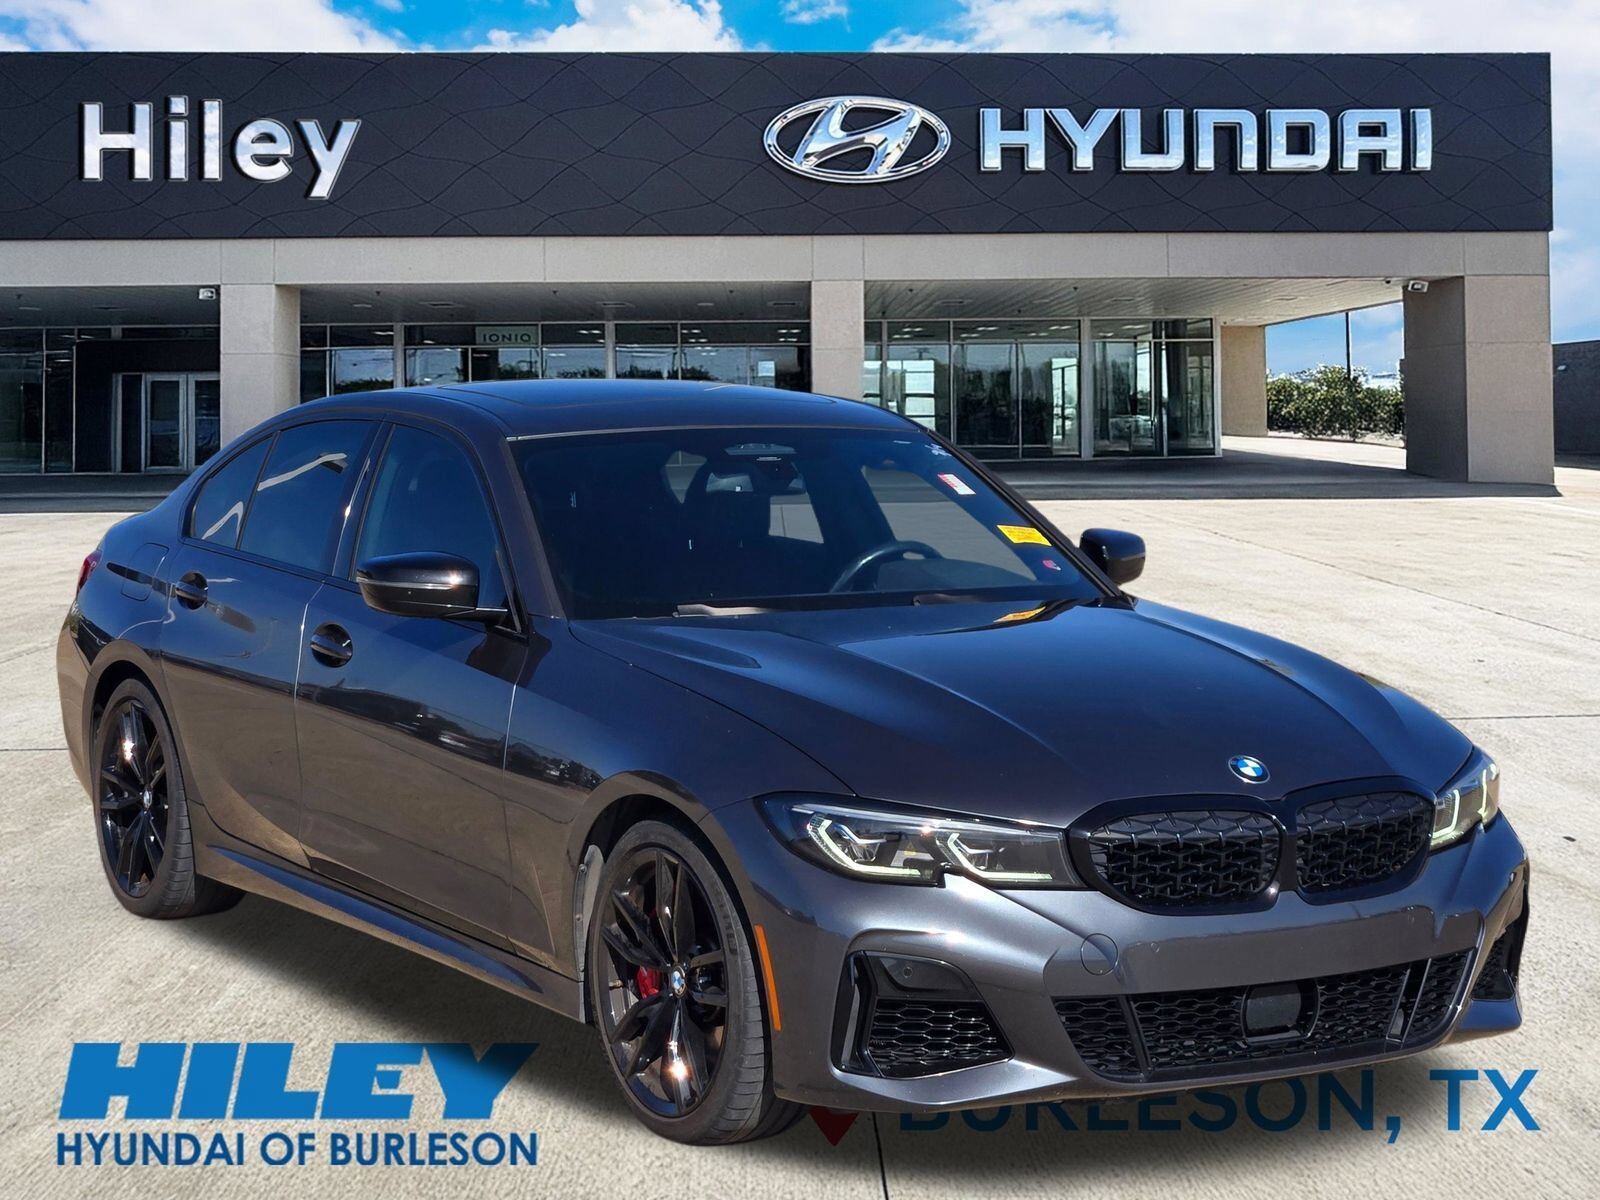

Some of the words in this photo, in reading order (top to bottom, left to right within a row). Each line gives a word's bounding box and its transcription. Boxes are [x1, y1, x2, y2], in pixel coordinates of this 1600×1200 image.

[79, 95, 361, 199] Hiley
[979, 108, 1433, 172] HYUNDAI
[483, 333, 532, 343] IONIQ
